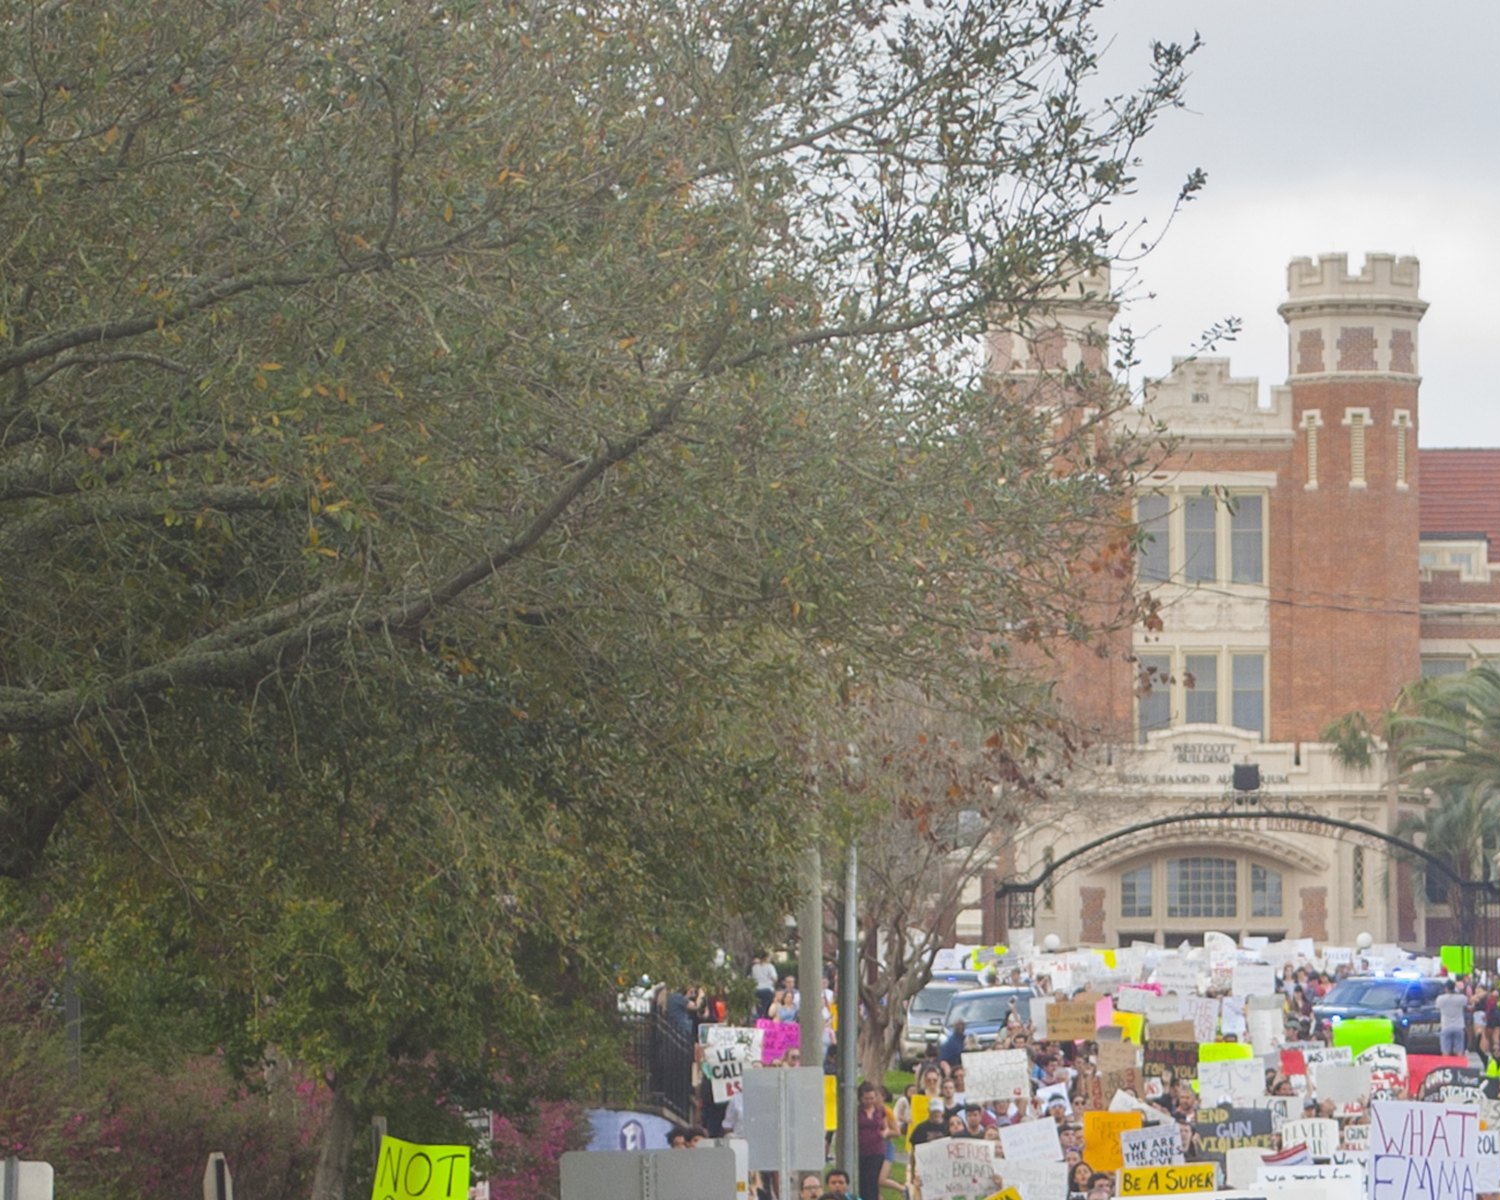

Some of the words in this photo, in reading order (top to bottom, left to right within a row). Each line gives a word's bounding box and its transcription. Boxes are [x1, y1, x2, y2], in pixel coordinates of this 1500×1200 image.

[1172, 743, 1237, 753] WESTCOTT
[1177, 754, 1230, 764] BUILDING
[1154, 774, 1210, 784] DIAMOND
[716, 1047, 737, 1062] WE
[1197, 1108, 1229, 1124] END
[1215, 1121, 1253, 1139] GUN
[1371, 1104, 1478, 1158] WHAT
[1128, 1141, 1147, 1152] WE
[1151, 1136, 1175, 1148] ARE
[1199, 1134, 1272, 1153] VIOLENCE
[1124, 1152, 1147, 1163] THE
[1149, 1145, 1184, 1160] ONES
[379, 1147, 466, 1197] NOT
[1146, 1171, 1160, 1191] A
